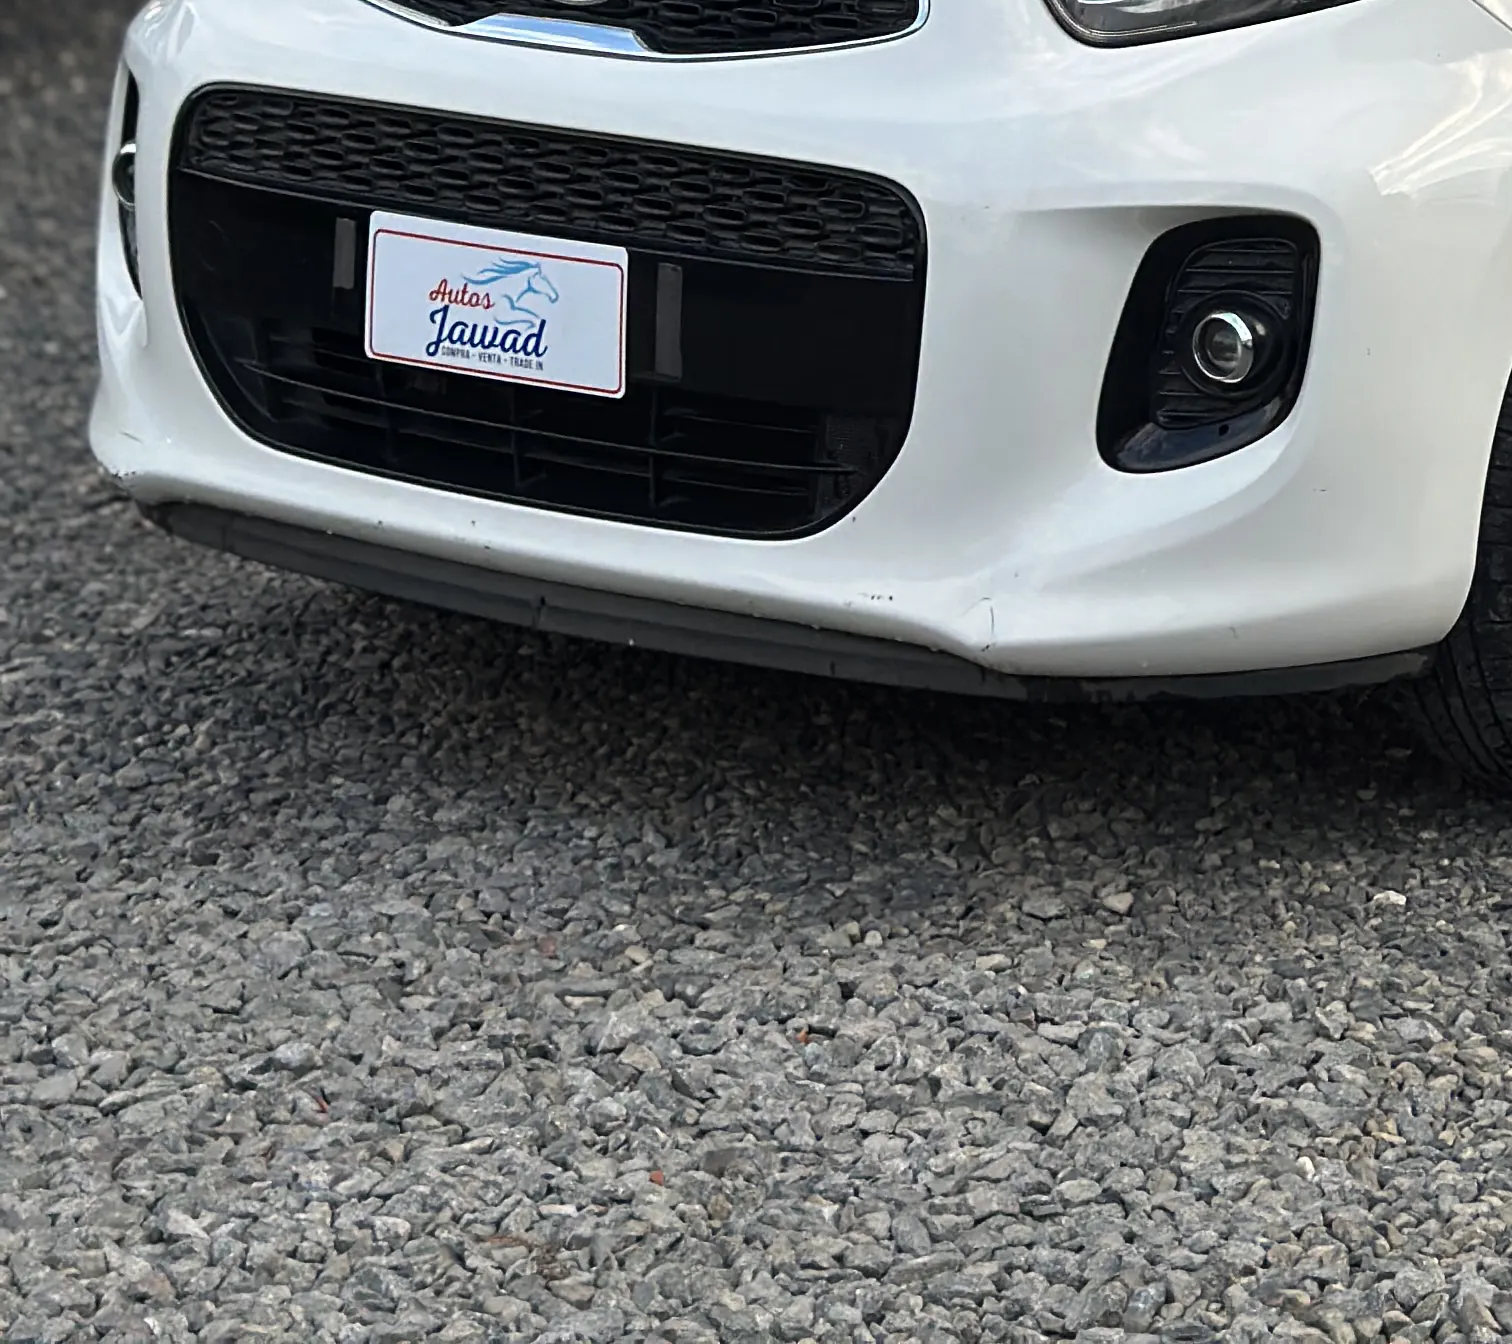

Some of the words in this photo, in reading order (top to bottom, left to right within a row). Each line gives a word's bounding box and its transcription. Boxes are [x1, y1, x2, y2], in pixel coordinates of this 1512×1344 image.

[429, 279, 495, 309] Autos
[426, 304, 549, 357] Jawad
[441, 346, 470, 359] COMPRA
[478, 351, 502, 365] VENTA
[511, 357, 533, 370] TRADE
[535, 360, 544, 371] IN
